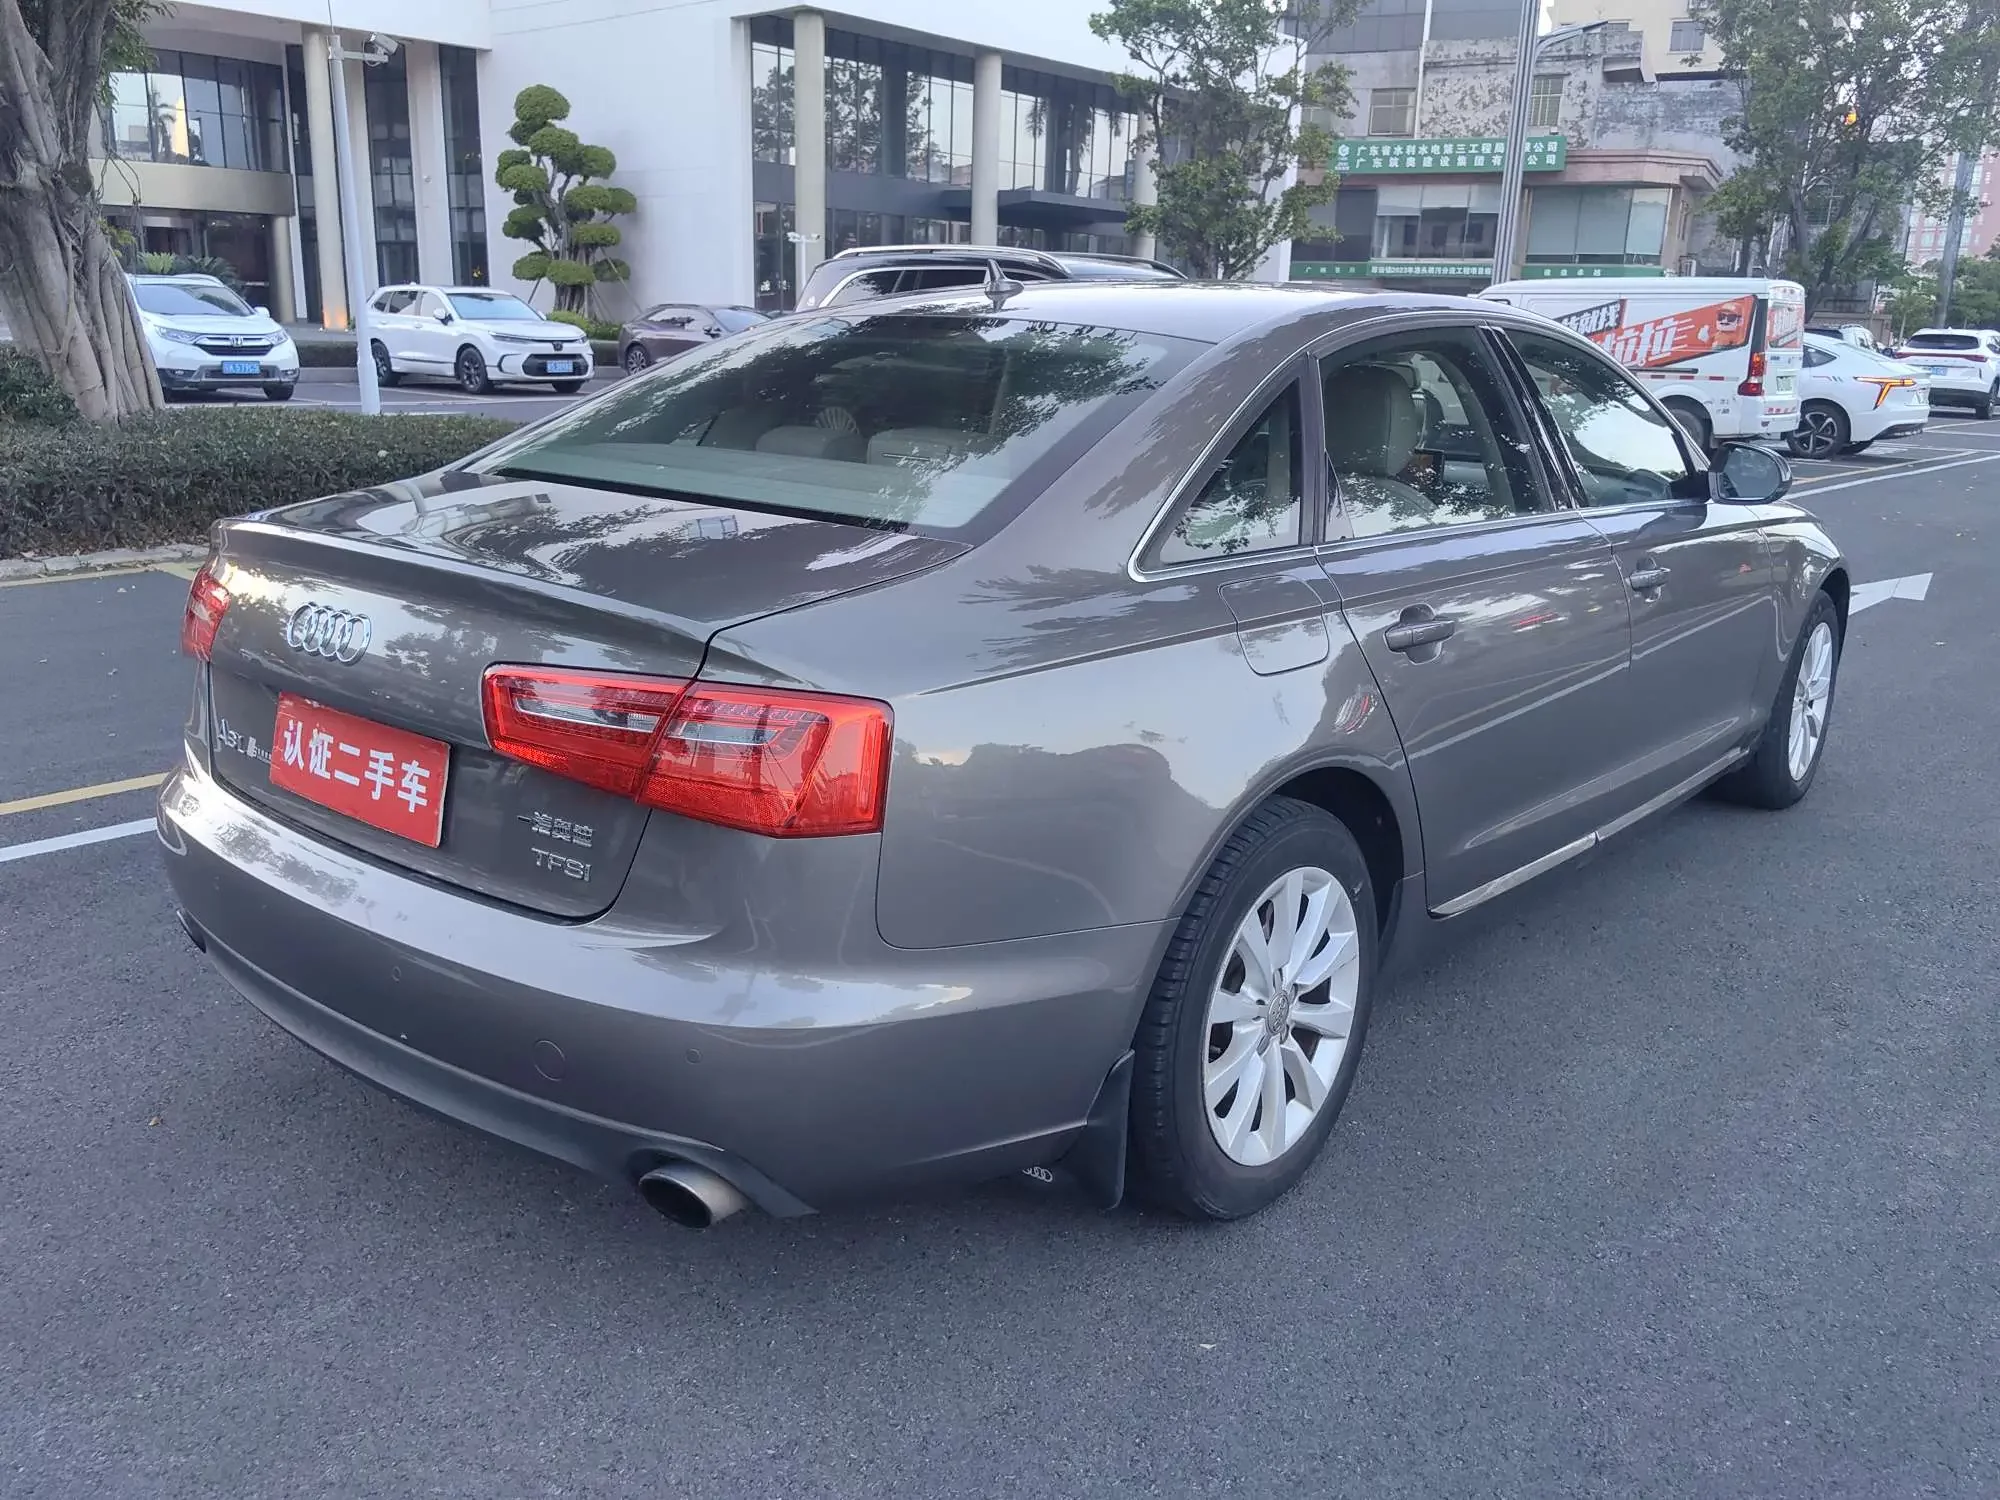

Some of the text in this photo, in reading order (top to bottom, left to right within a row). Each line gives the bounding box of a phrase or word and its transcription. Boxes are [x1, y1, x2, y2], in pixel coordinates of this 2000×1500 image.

[1356, 141, 1558, 157] 广东省水利水电第三工程局限公司
[283, 719, 430, 813] 认证二手车
